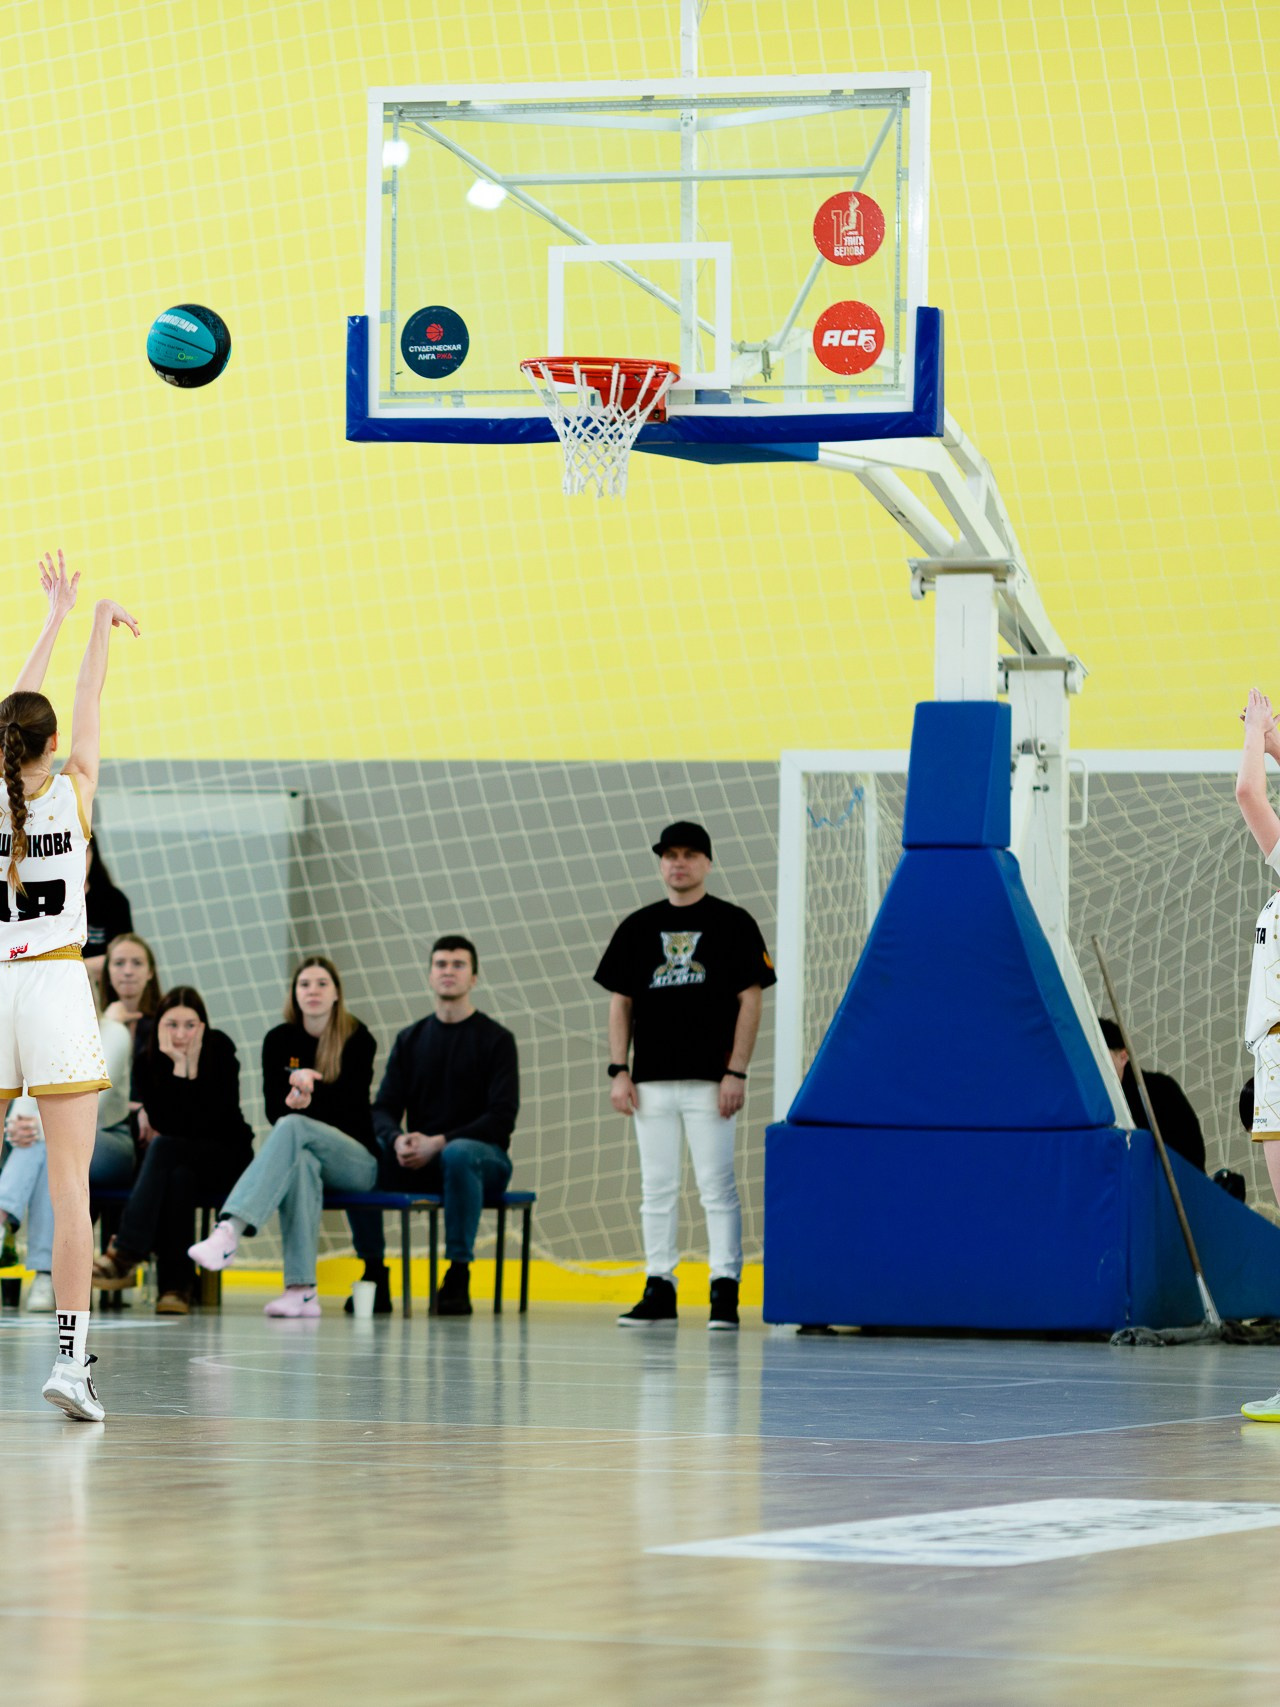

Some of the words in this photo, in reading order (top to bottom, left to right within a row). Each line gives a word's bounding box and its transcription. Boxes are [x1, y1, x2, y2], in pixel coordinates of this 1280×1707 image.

[822, 329, 876, 352] АСБ
[408, 344, 462, 352] СТУДЕНЧЕСКАЯ
[417, 353, 436, 361] ЛИГА
